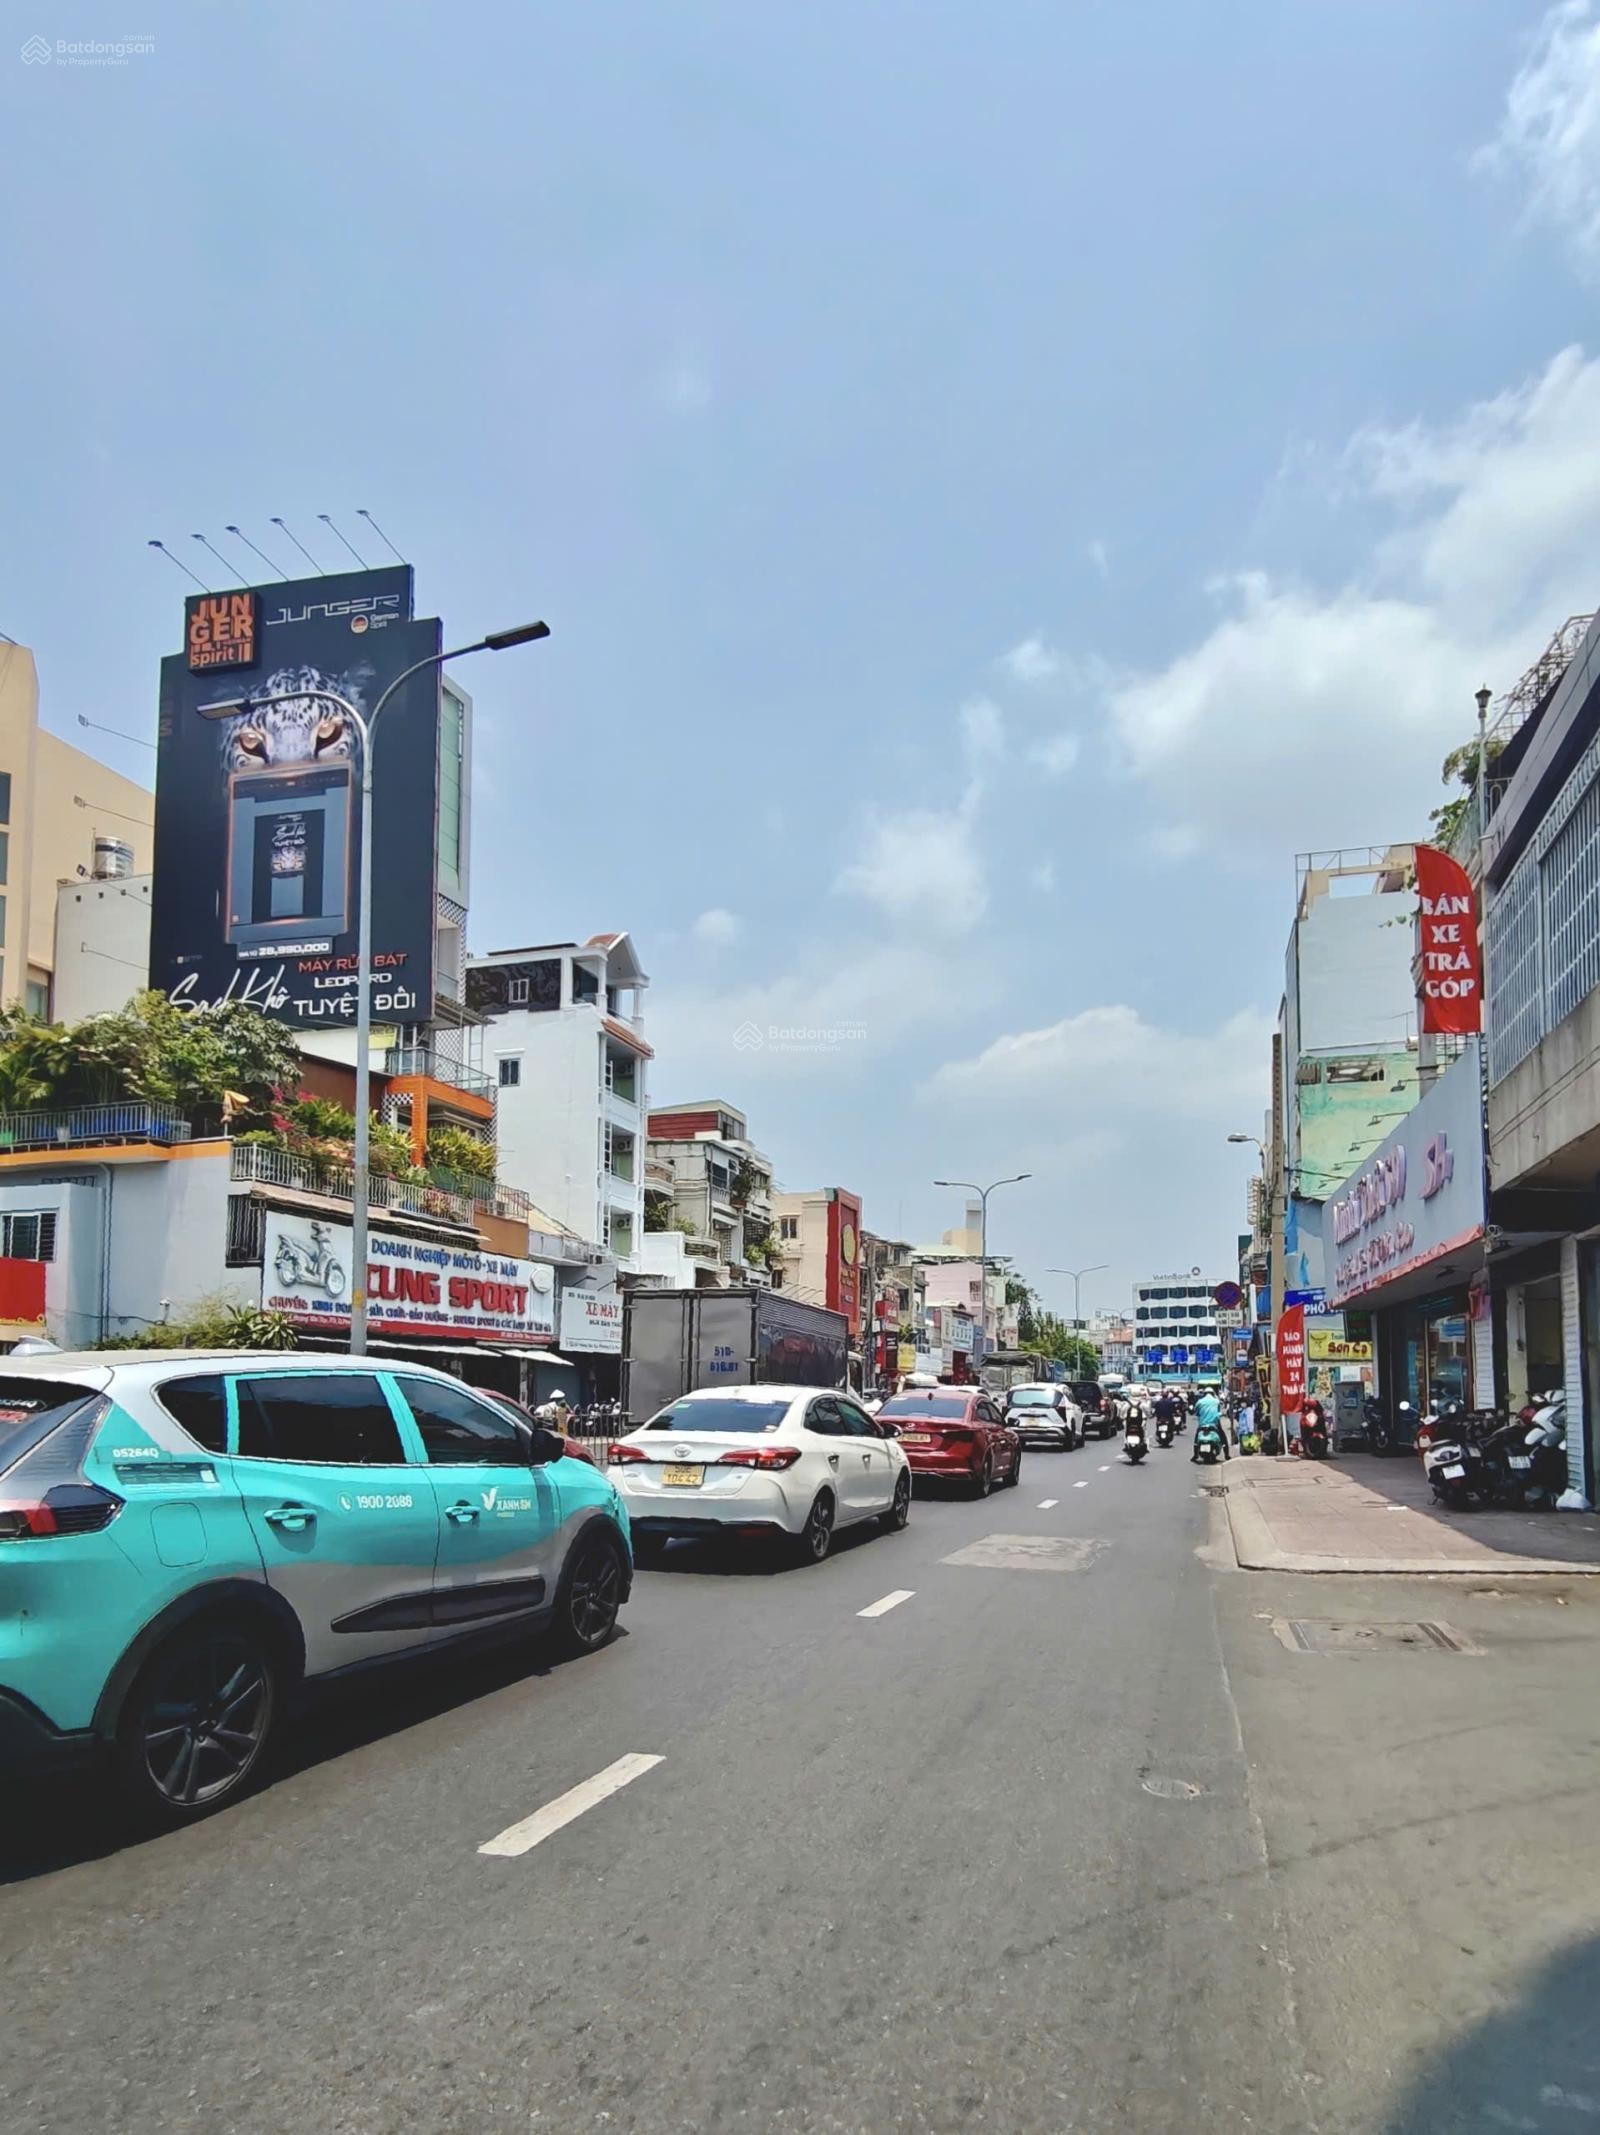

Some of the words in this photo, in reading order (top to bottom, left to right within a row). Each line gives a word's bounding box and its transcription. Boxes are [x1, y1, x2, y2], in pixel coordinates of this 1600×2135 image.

[191, 593, 251, 621] JUN
[266, 594, 400, 626] JUNGER
[189, 615, 254, 644] GER
[1422, 893, 1470, 916] BÁN
[1431, 924, 1462, 944] XE
[298, 957, 333, 973] MÁY
[374, 952, 407, 967] BÁT
[1425, 945, 1472, 971] TRẢ
[314, 972, 393, 988] LEOPRD
[1425, 976, 1476, 998] GÓP
[371, 1238, 413, 1259] DOANH
[448, 1276, 529, 1316] SPORT
[585, 1301, 598, 1316] XE
